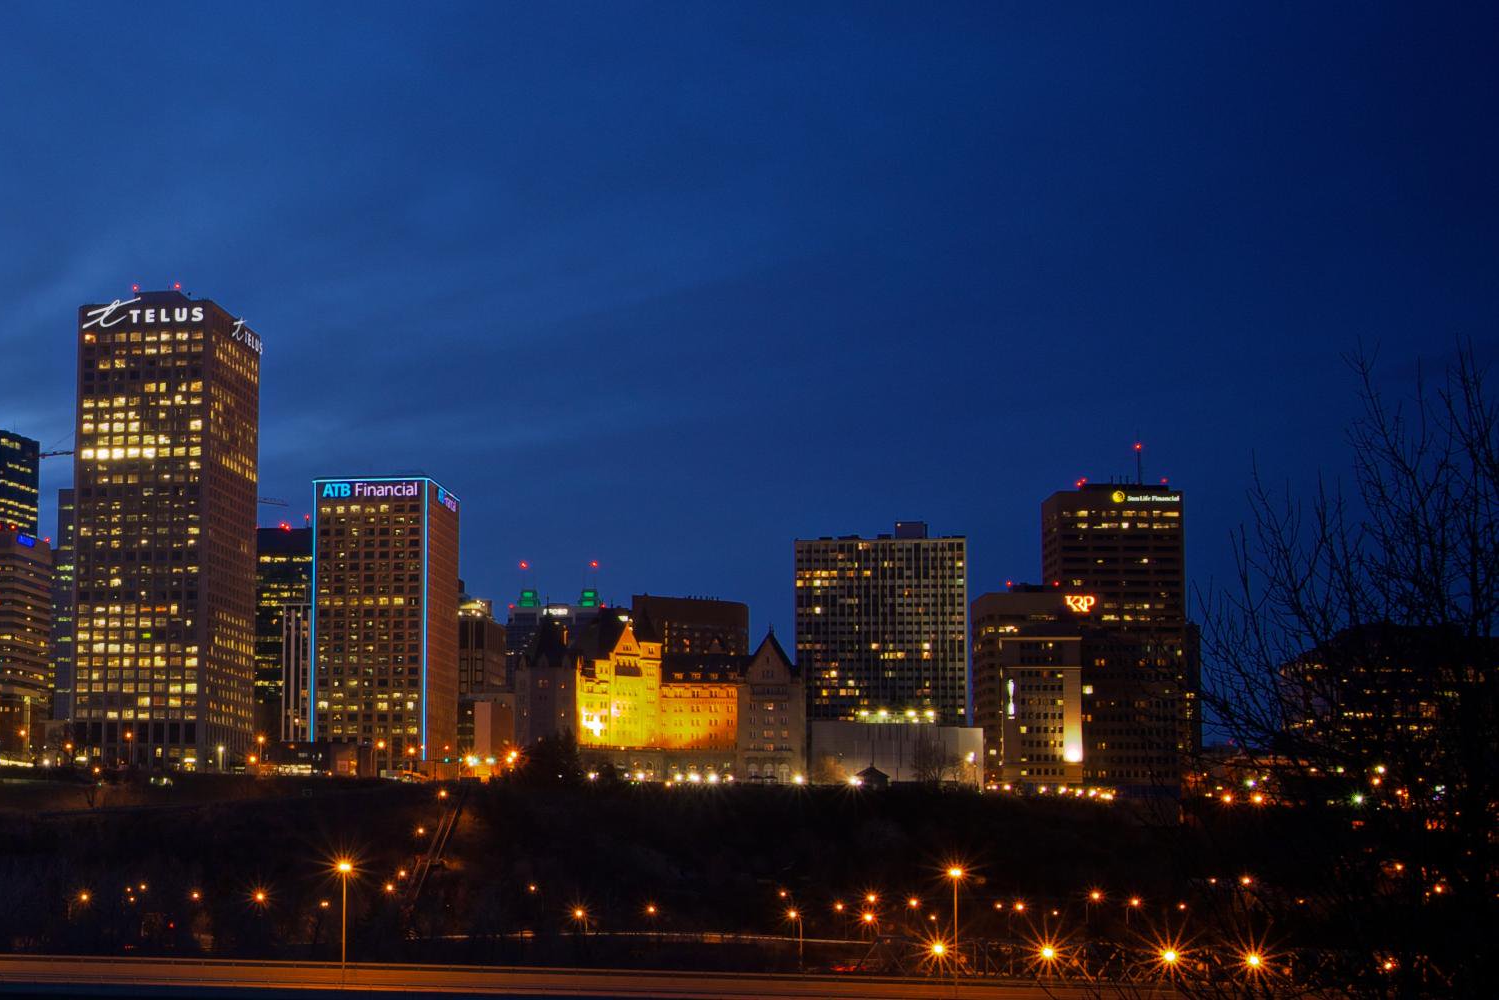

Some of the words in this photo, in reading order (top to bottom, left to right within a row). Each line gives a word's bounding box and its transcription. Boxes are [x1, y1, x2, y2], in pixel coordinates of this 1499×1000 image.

[129, 307, 203, 324] TELUS
[322, 483, 351, 497] ATB
[355, 482, 418, 497] Financial
[1140, 494, 1151, 502] Life
